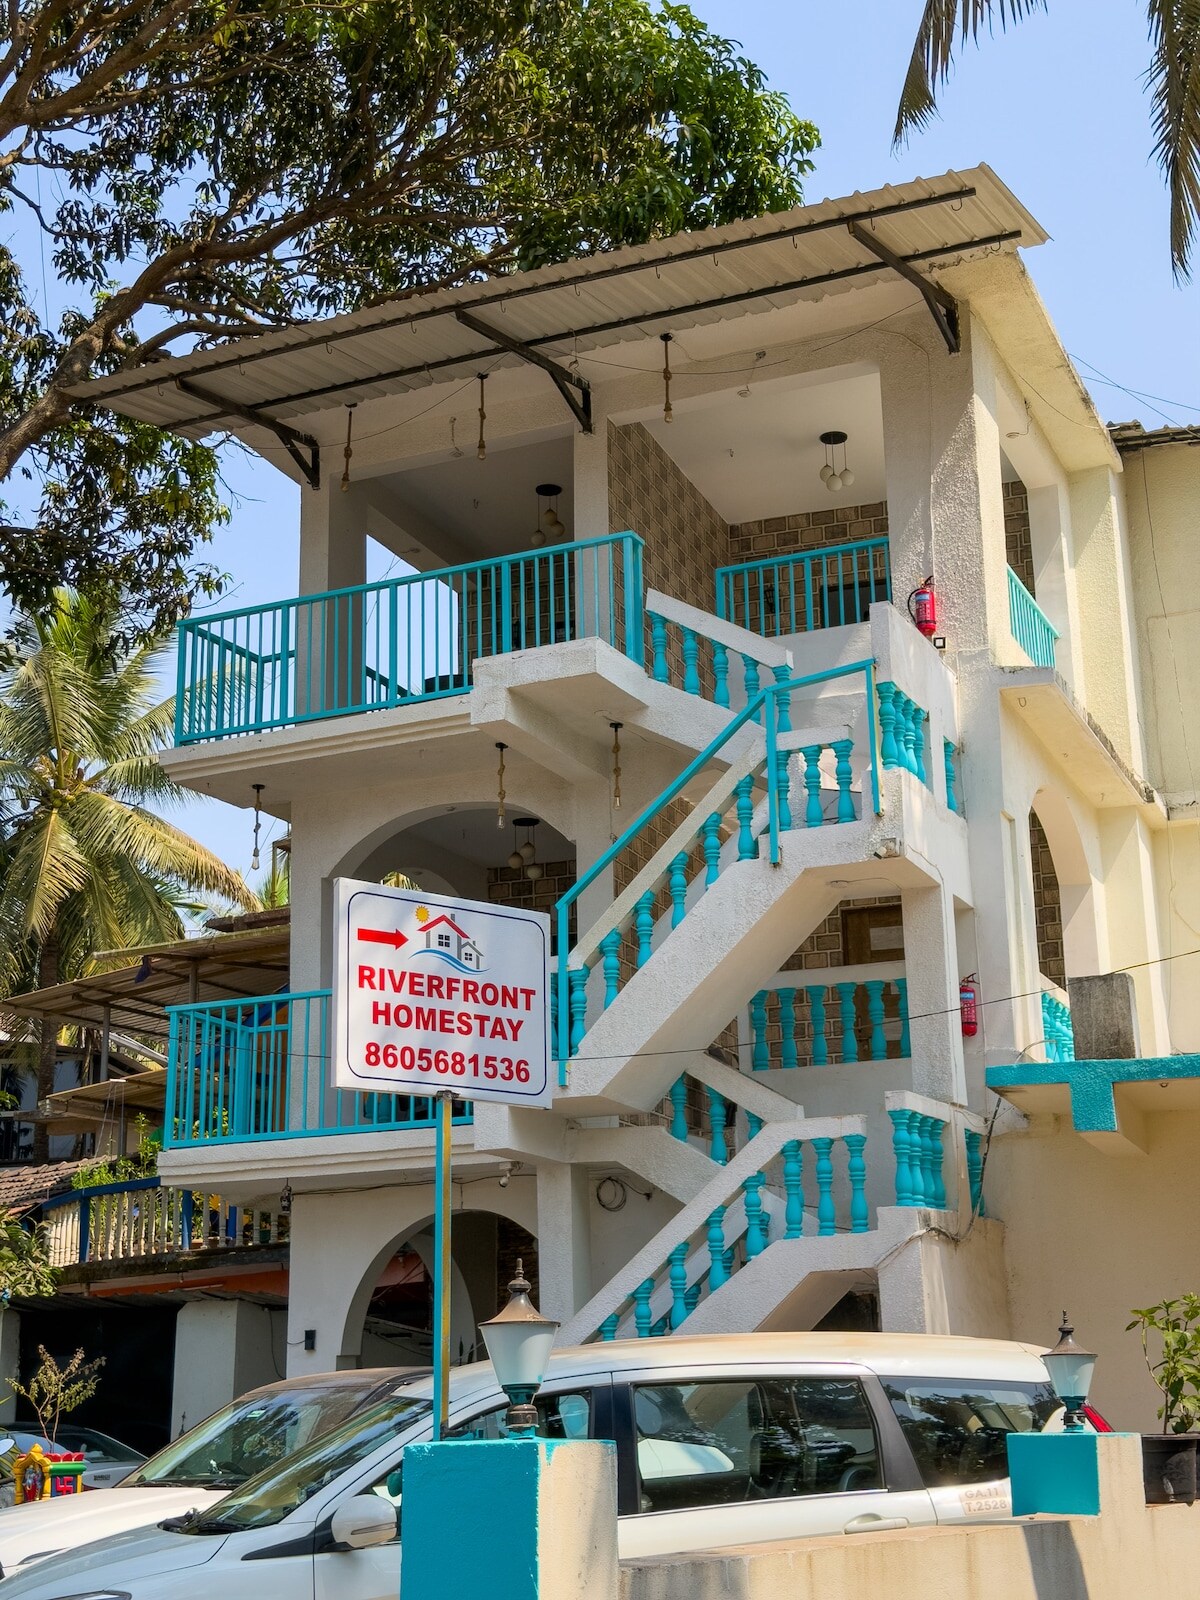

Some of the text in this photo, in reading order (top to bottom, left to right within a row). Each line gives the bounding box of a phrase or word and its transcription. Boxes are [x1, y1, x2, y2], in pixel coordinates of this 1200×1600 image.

[358, 965, 536, 1011] RIVERFRONT
[372, 1001, 524, 1042] HOMESTAY
[365, 1042, 530, 1083] 8605681536
